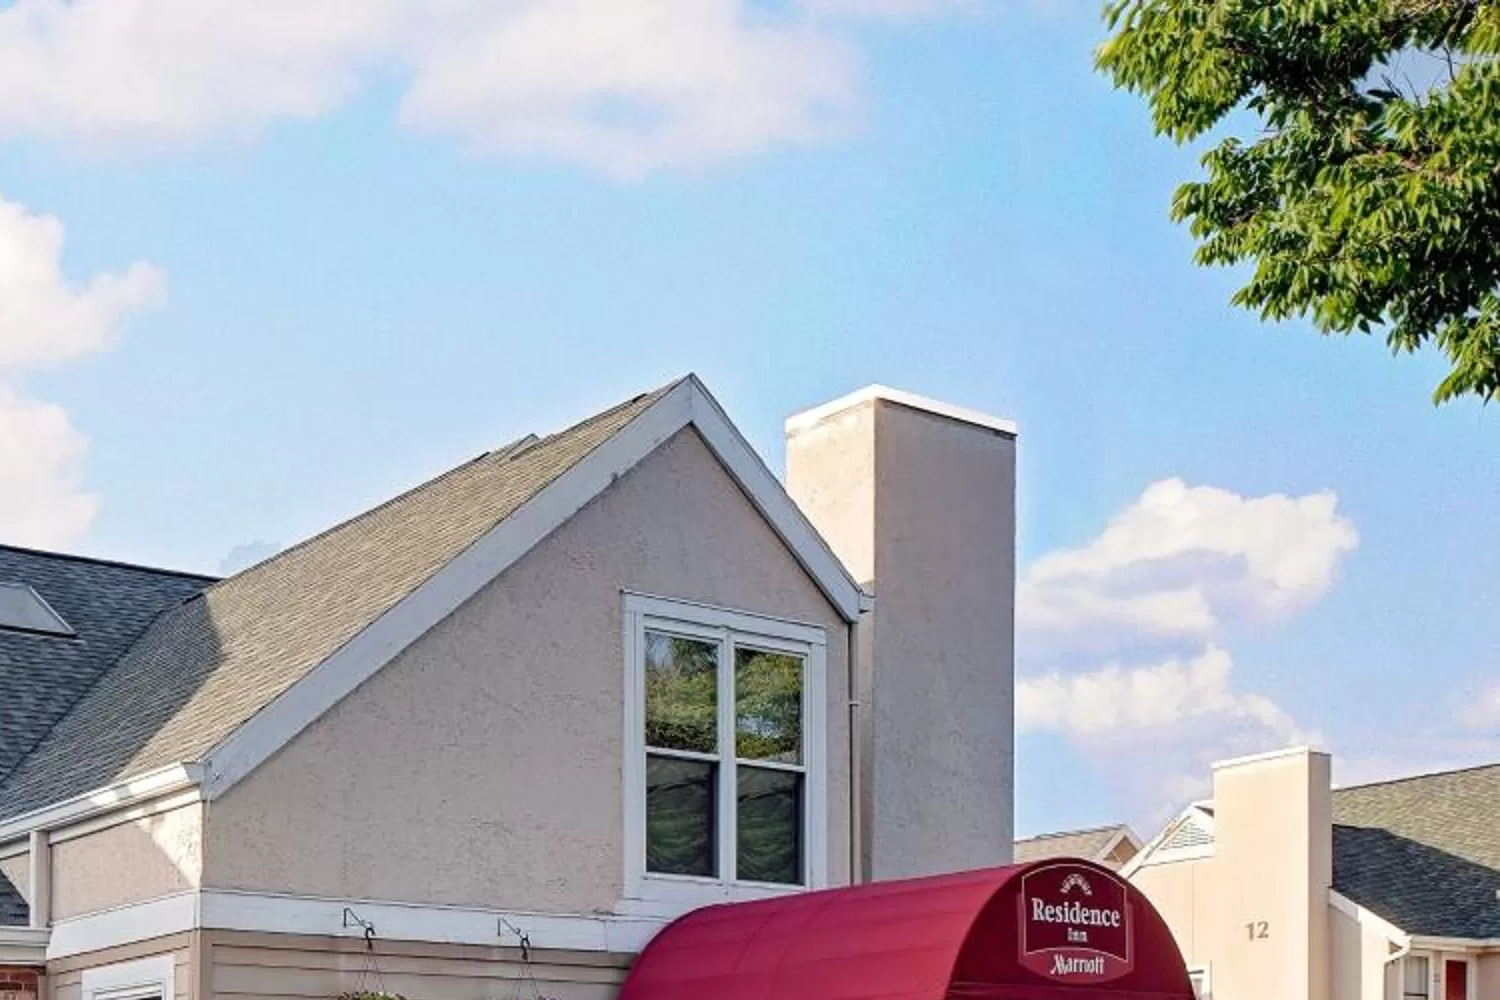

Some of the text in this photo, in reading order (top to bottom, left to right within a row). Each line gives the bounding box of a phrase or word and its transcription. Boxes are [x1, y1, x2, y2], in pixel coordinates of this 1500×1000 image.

[1031, 897, 1121, 927] Residence
[1245, 921, 1269, 940] 12
[1050, 953, 1104, 975] Marriott
